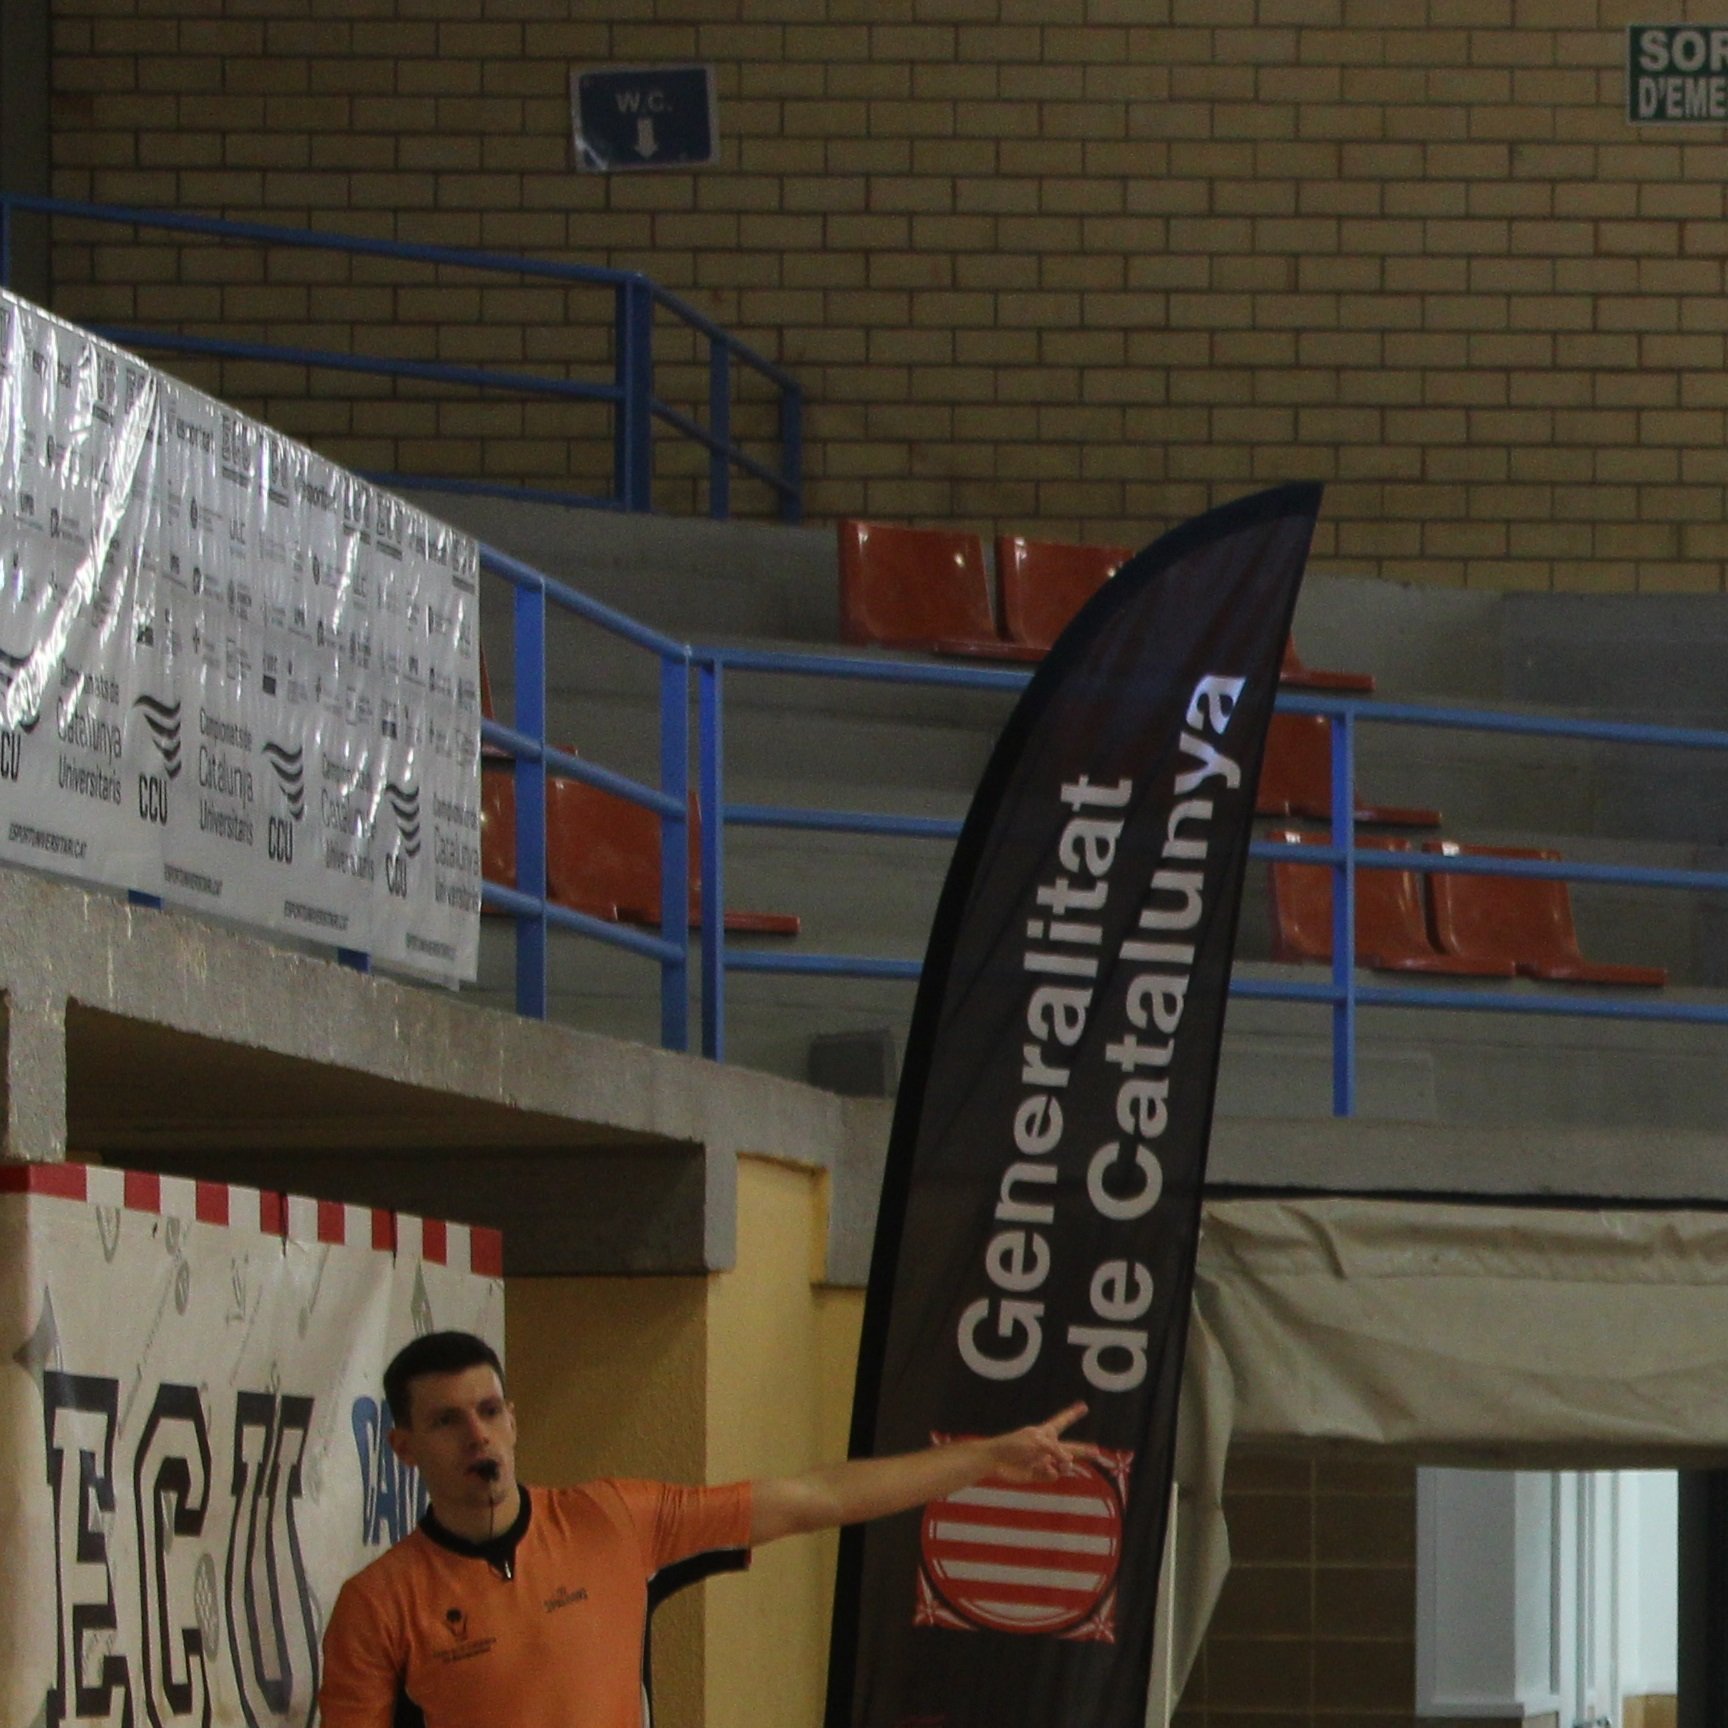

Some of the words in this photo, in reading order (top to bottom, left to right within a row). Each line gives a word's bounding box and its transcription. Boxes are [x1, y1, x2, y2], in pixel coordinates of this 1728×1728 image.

[59, 754, 122, 805] Universitaris
[138, 771, 168, 827] CCU
[267, 815, 294, 865] CCU
[1087, 673, 1248, 1221] Catalunya
[957, 774, 1132, 1382] Generalitat
[1067, 1257, 1155, 1393] de
